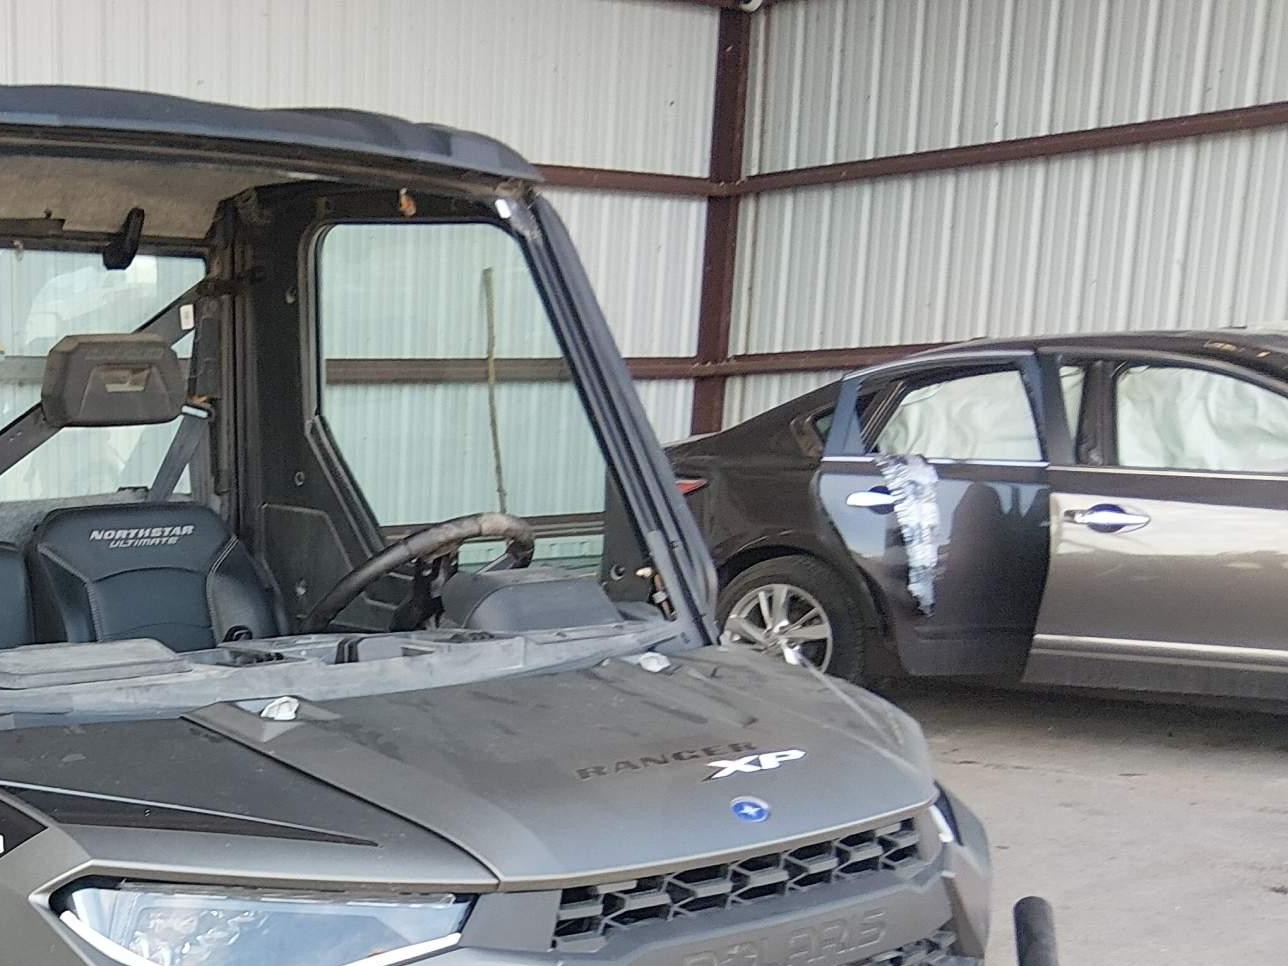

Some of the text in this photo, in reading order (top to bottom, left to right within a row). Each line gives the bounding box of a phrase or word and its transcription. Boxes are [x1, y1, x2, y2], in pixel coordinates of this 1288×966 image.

[89, 525, 194, 541] NORTHSTAR
[109, 536, 179, 549] ULTIMATE
[575, 741, 807, 781] RANGER XP
